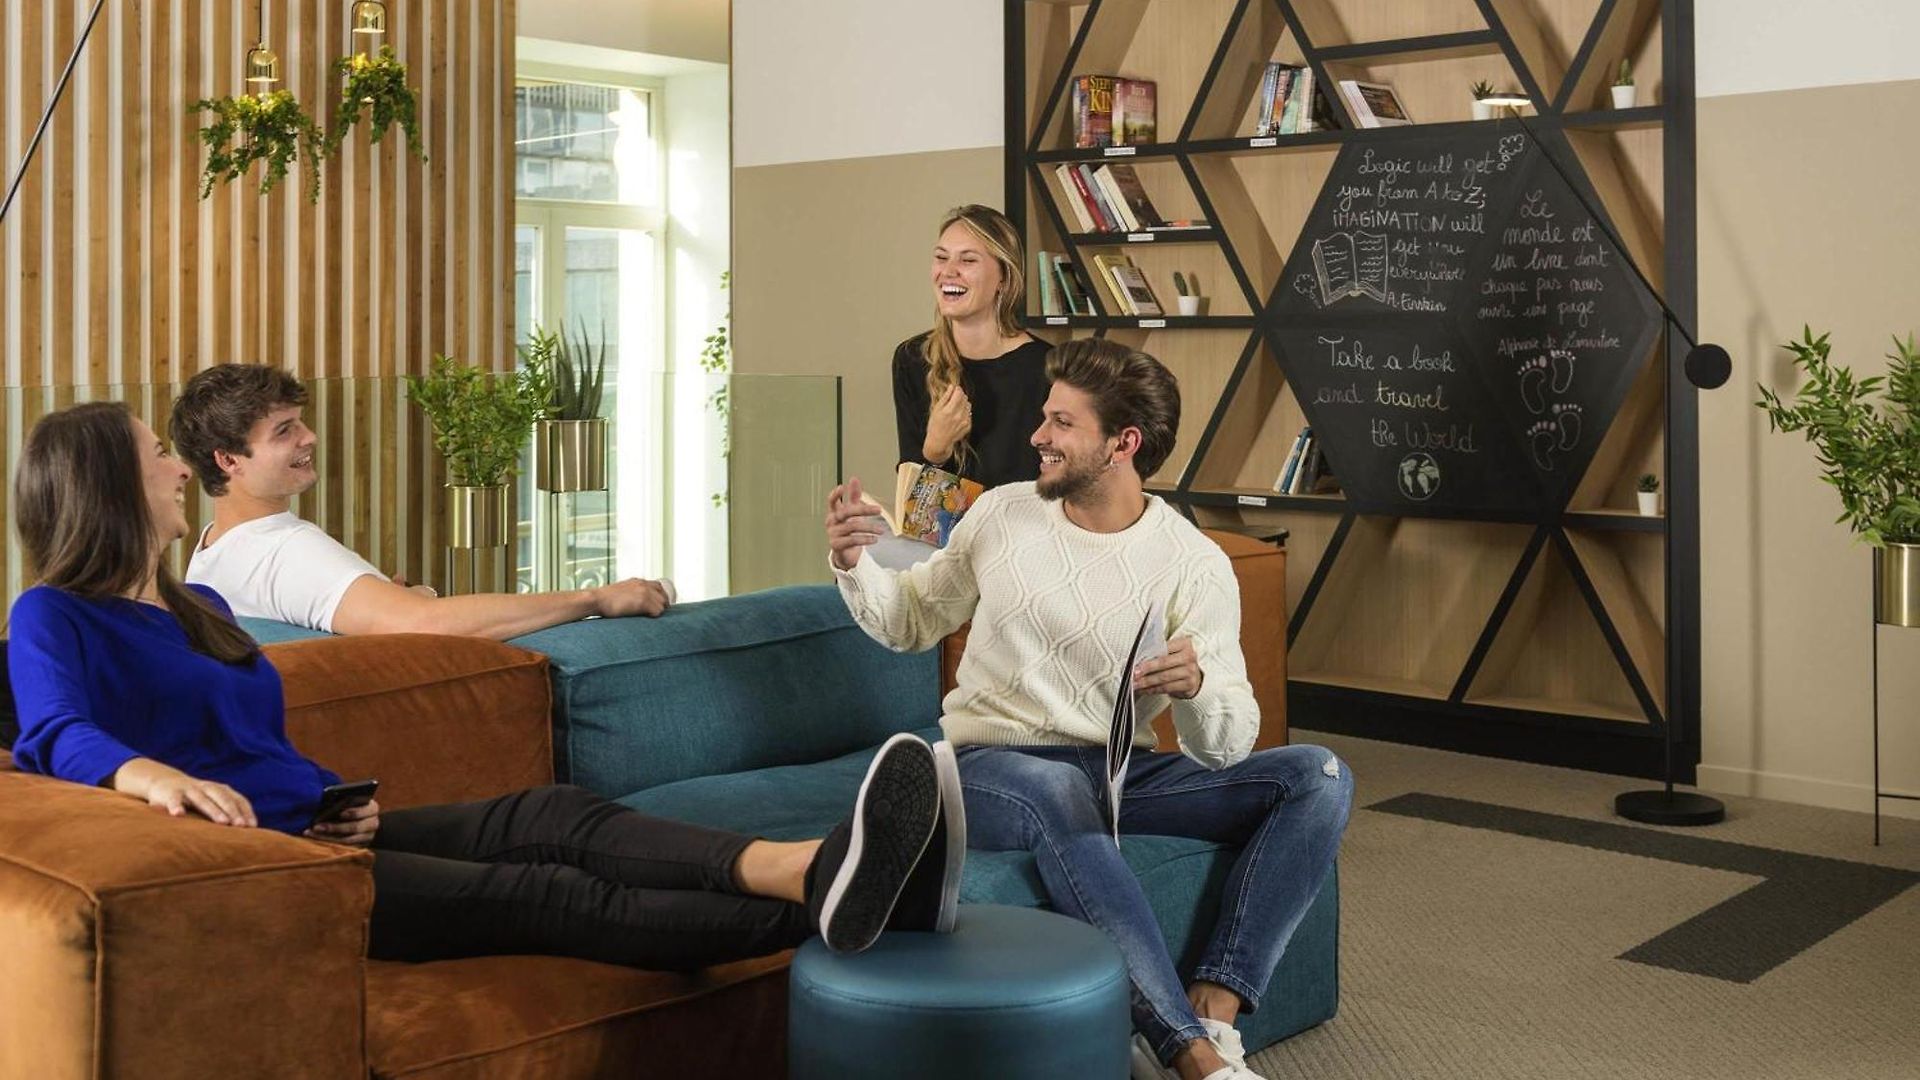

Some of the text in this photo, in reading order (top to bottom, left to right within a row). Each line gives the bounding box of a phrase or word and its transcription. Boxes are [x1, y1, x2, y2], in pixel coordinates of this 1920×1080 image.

[1358, 149, 1495, 189] Logic will get
[1336, 185, 1374, 212] you
[1377, 180, 1419, 207] from
[1424, 181, 1438, 199] A
[1442, 182, 1464, 201] to
[1520, 189, 1555, 218] Le
[1451, 213, 1485, 234] will
[1503, 220, 1595, 245] monde est
[1392, 237, 1421, 267] get
[1524, 248, 1567, 270] livre
[1575, 245, 1609, 267] dont
[1481, 278, 1528, 304] chaque
[1536, 277, 1562, 301] pas
[1558, 301, 1596, 327] page
[1318, 336, 1456, 372] Take a book
[1313, 380, 1449, 411] and travel
[1371, 418, 1479, 452] the World
